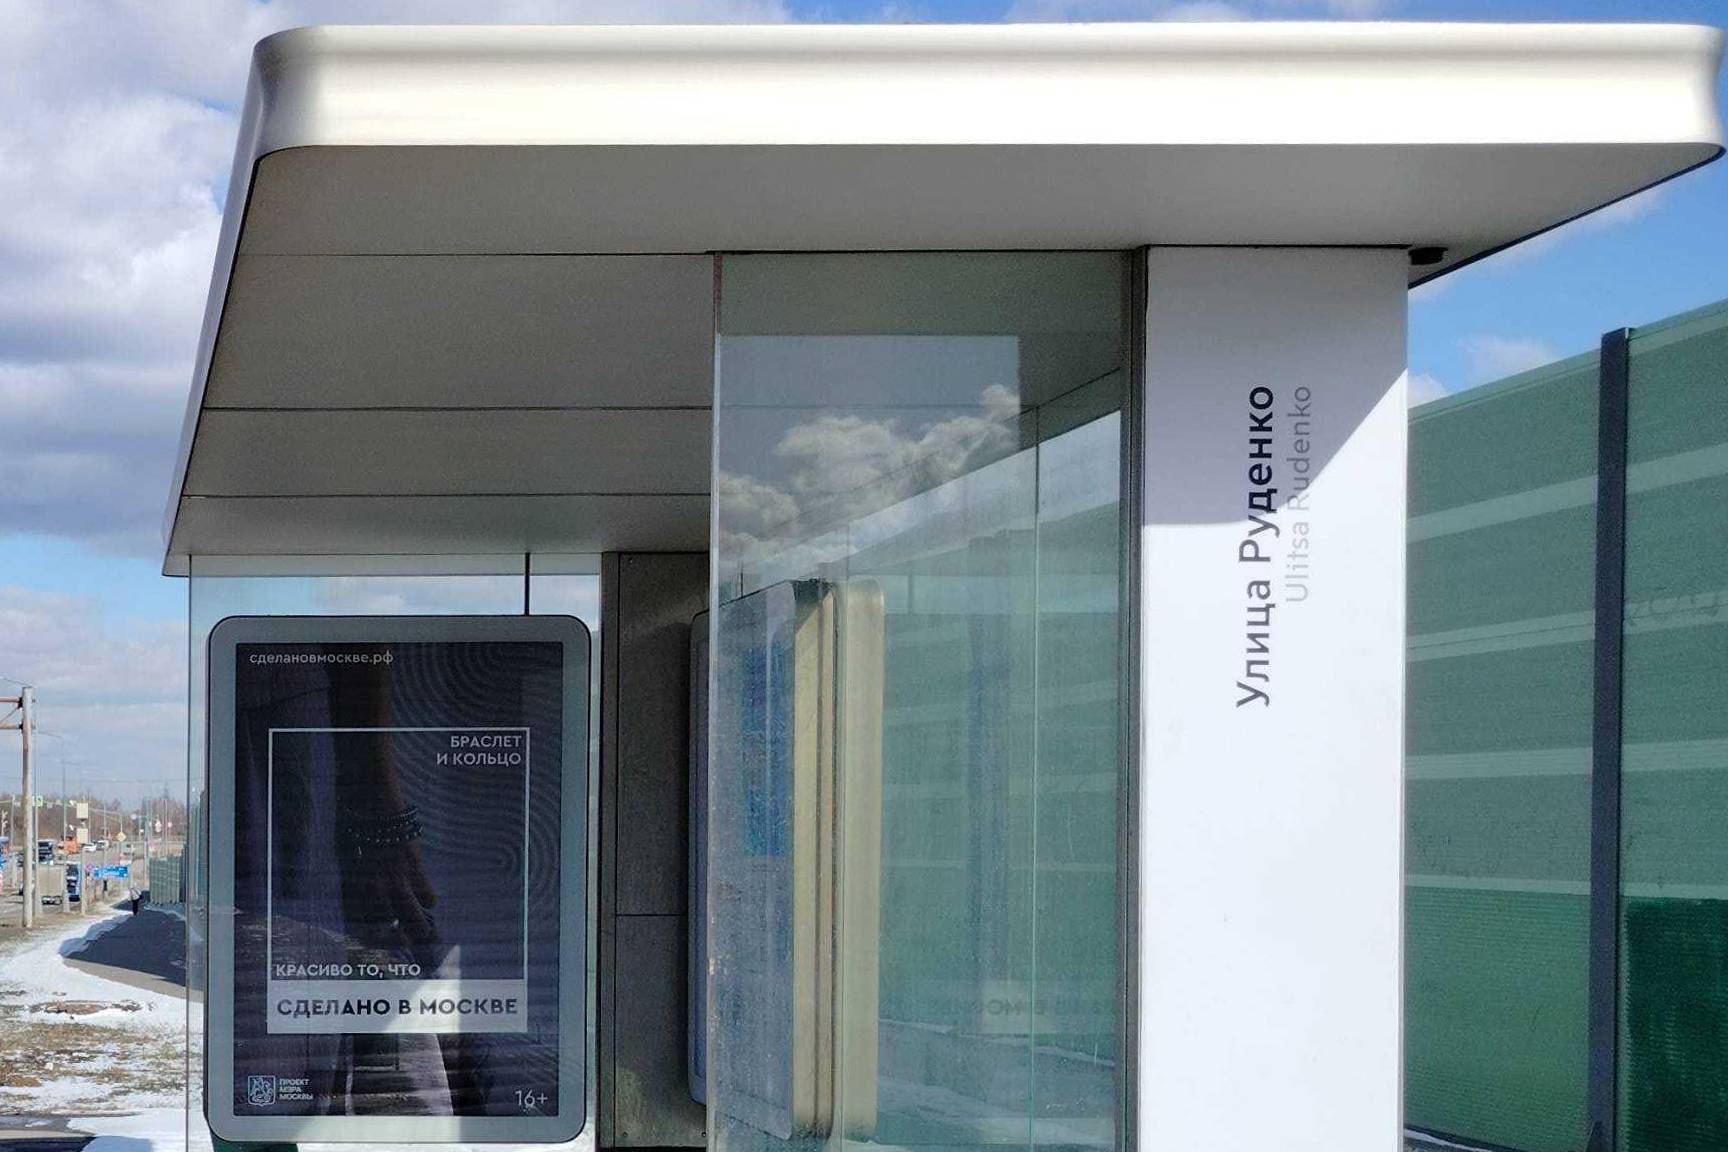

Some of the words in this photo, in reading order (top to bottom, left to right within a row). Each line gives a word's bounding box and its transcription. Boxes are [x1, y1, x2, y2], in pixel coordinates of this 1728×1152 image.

[1286, 386, 1311, 511] Rudenko
[1238, 386, 1280, 563] Руденко
[1285, 521, 1310, 603] Ulitsa
[1236, 579, 1276, 708] Улица
[249, 649, 394, 666] сделановмоскве.рф
[450, 735, 522, 748] БРАСЛЕТ
[436, 753, 448, 765] И
[453, 752, 522, 767] КОЛЬЦО
[275, 963, 353, 976] КРАСИВО
[357, 963, 384, 978] ТО,
[388, 963, 421, 976] ЧТО
[277, 998, 391, 1018] СДЕЛАНО
[399, 999, 412, 1015] В
[420, 998, 519, 1015] МОСКВЕ
[515, 1090, 548, 1107] 16+
